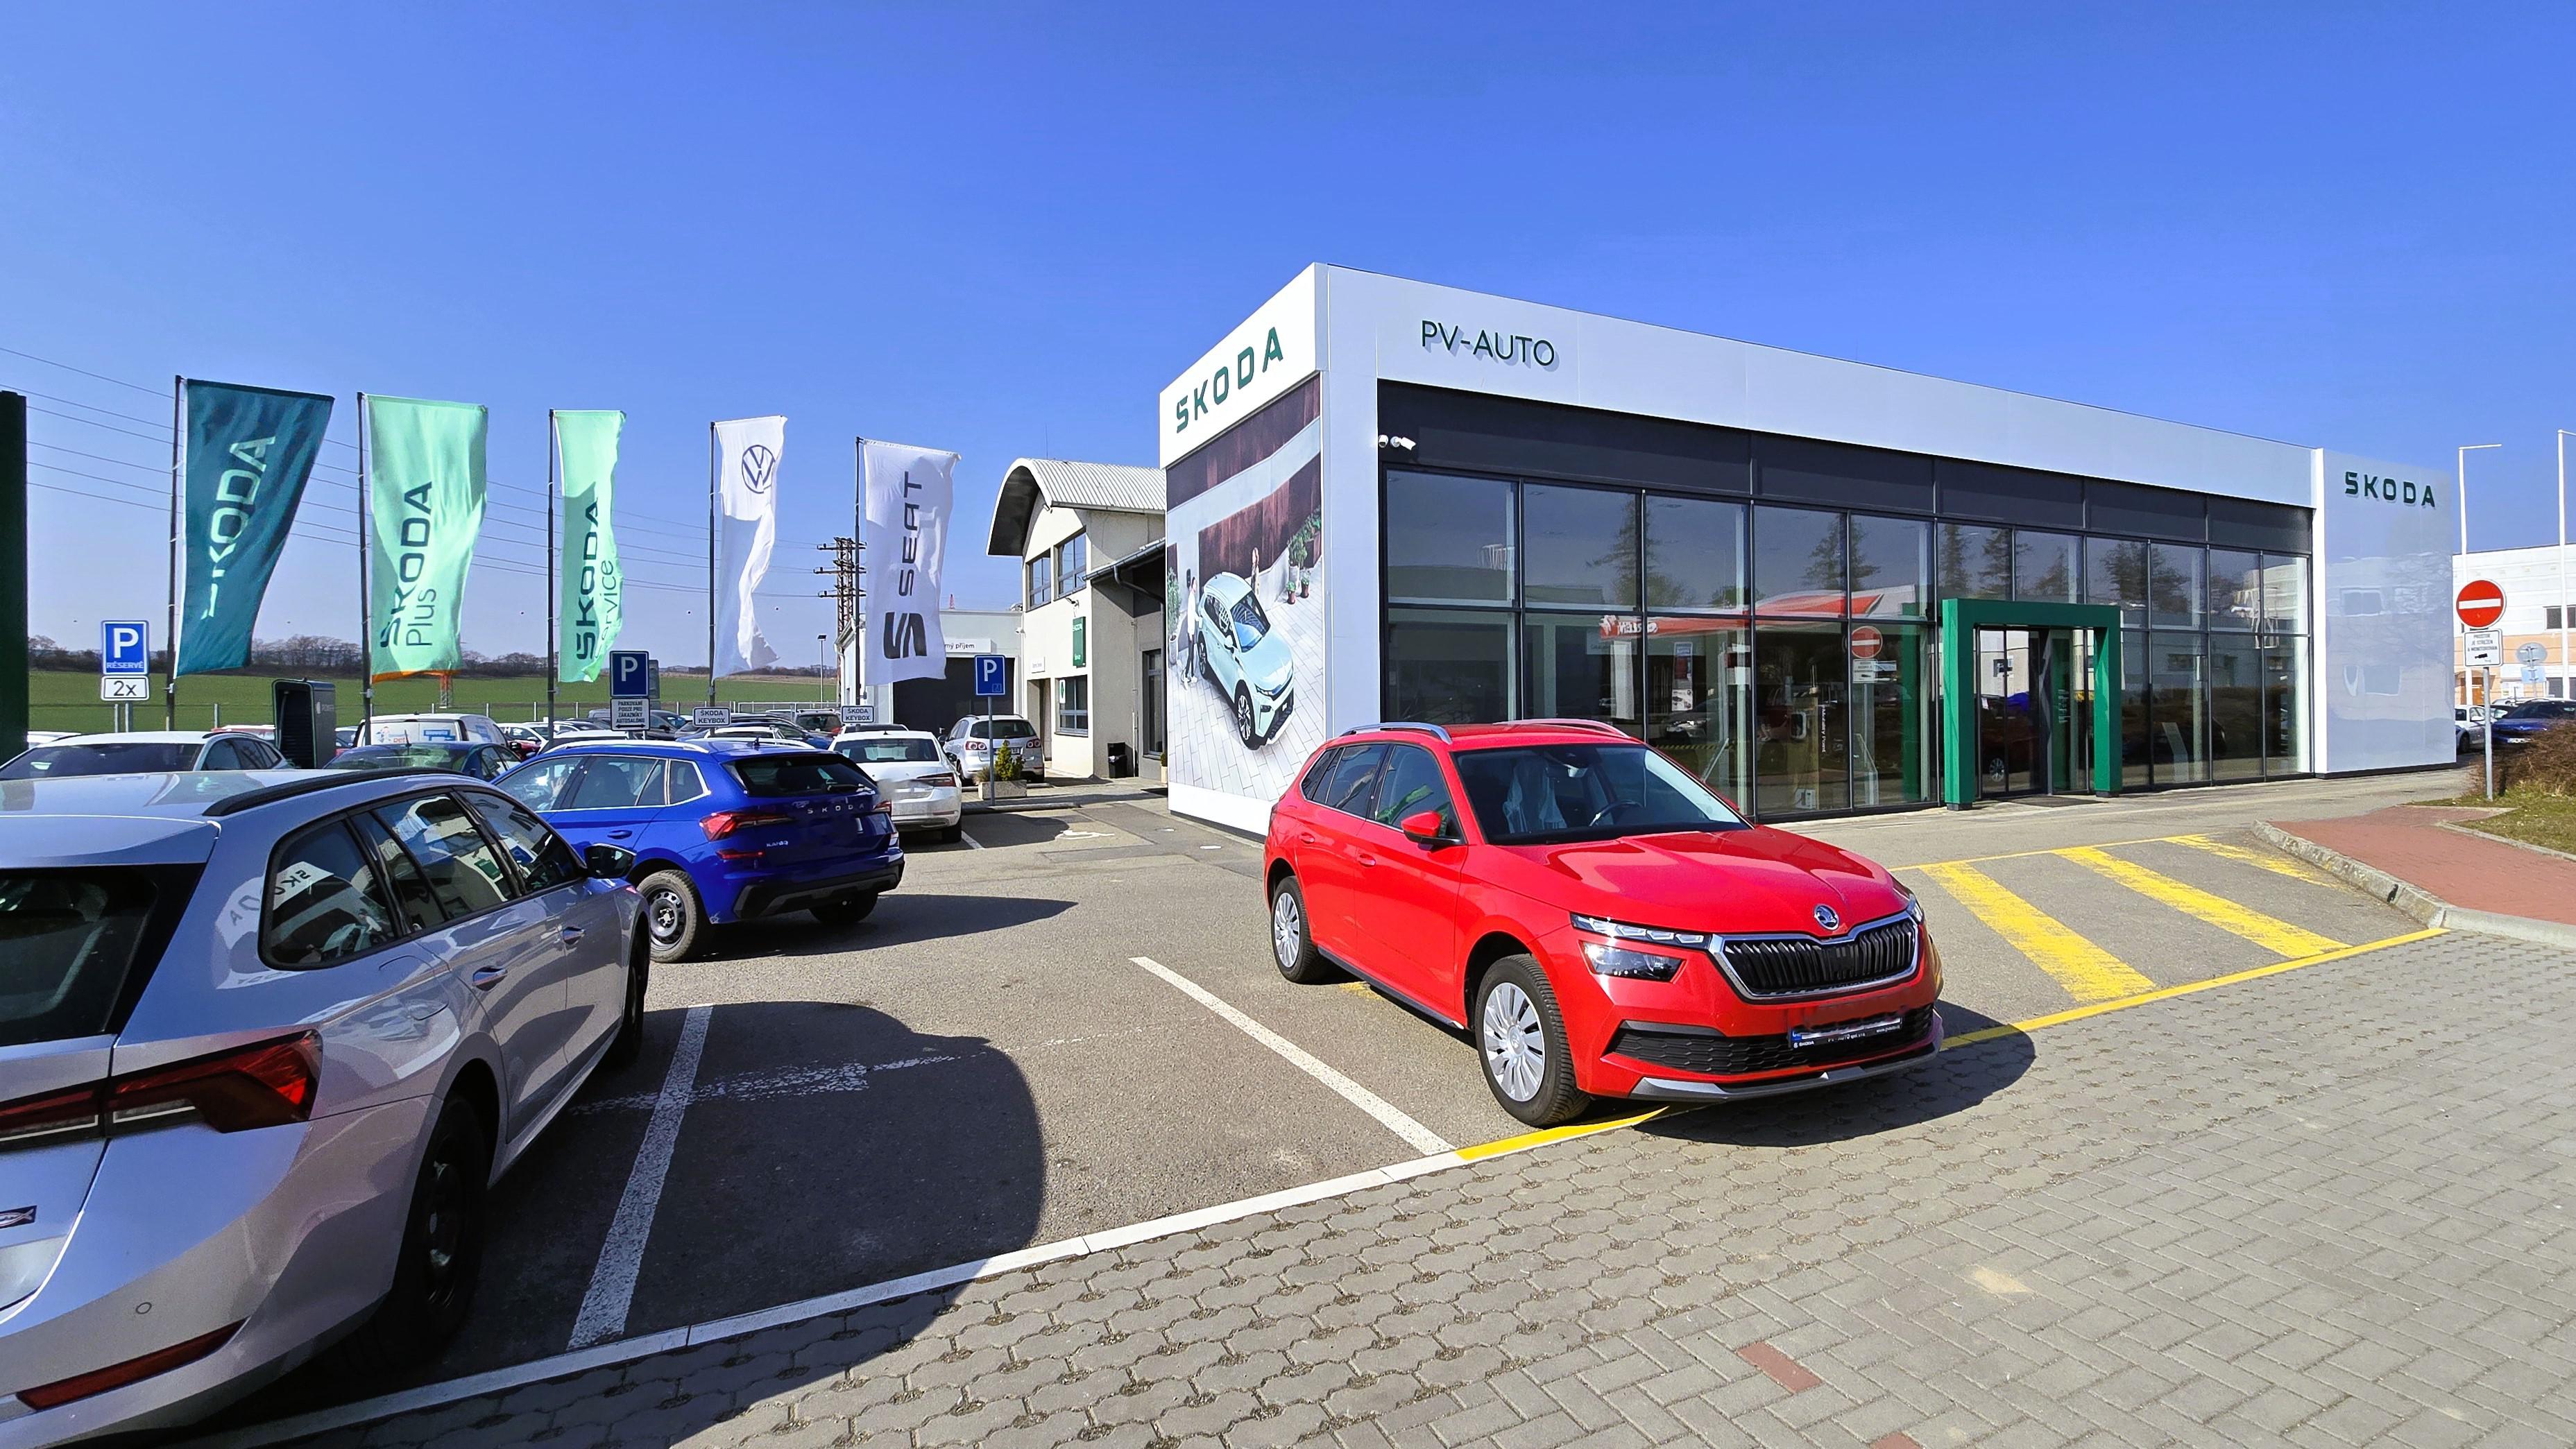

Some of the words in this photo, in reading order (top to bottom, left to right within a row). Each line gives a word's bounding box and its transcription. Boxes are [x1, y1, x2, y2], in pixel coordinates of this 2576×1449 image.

[1422, 320, 1555, 366] PV-AUTO
[898, 471, 922, 597] SEAT
[406, 588, 437, 646] Plus
[114, 628, 139, 658] P
[621, 656, 638, 682] P
[983, 659, 997, 682] P
[114, 680, 137, 696] 2x
